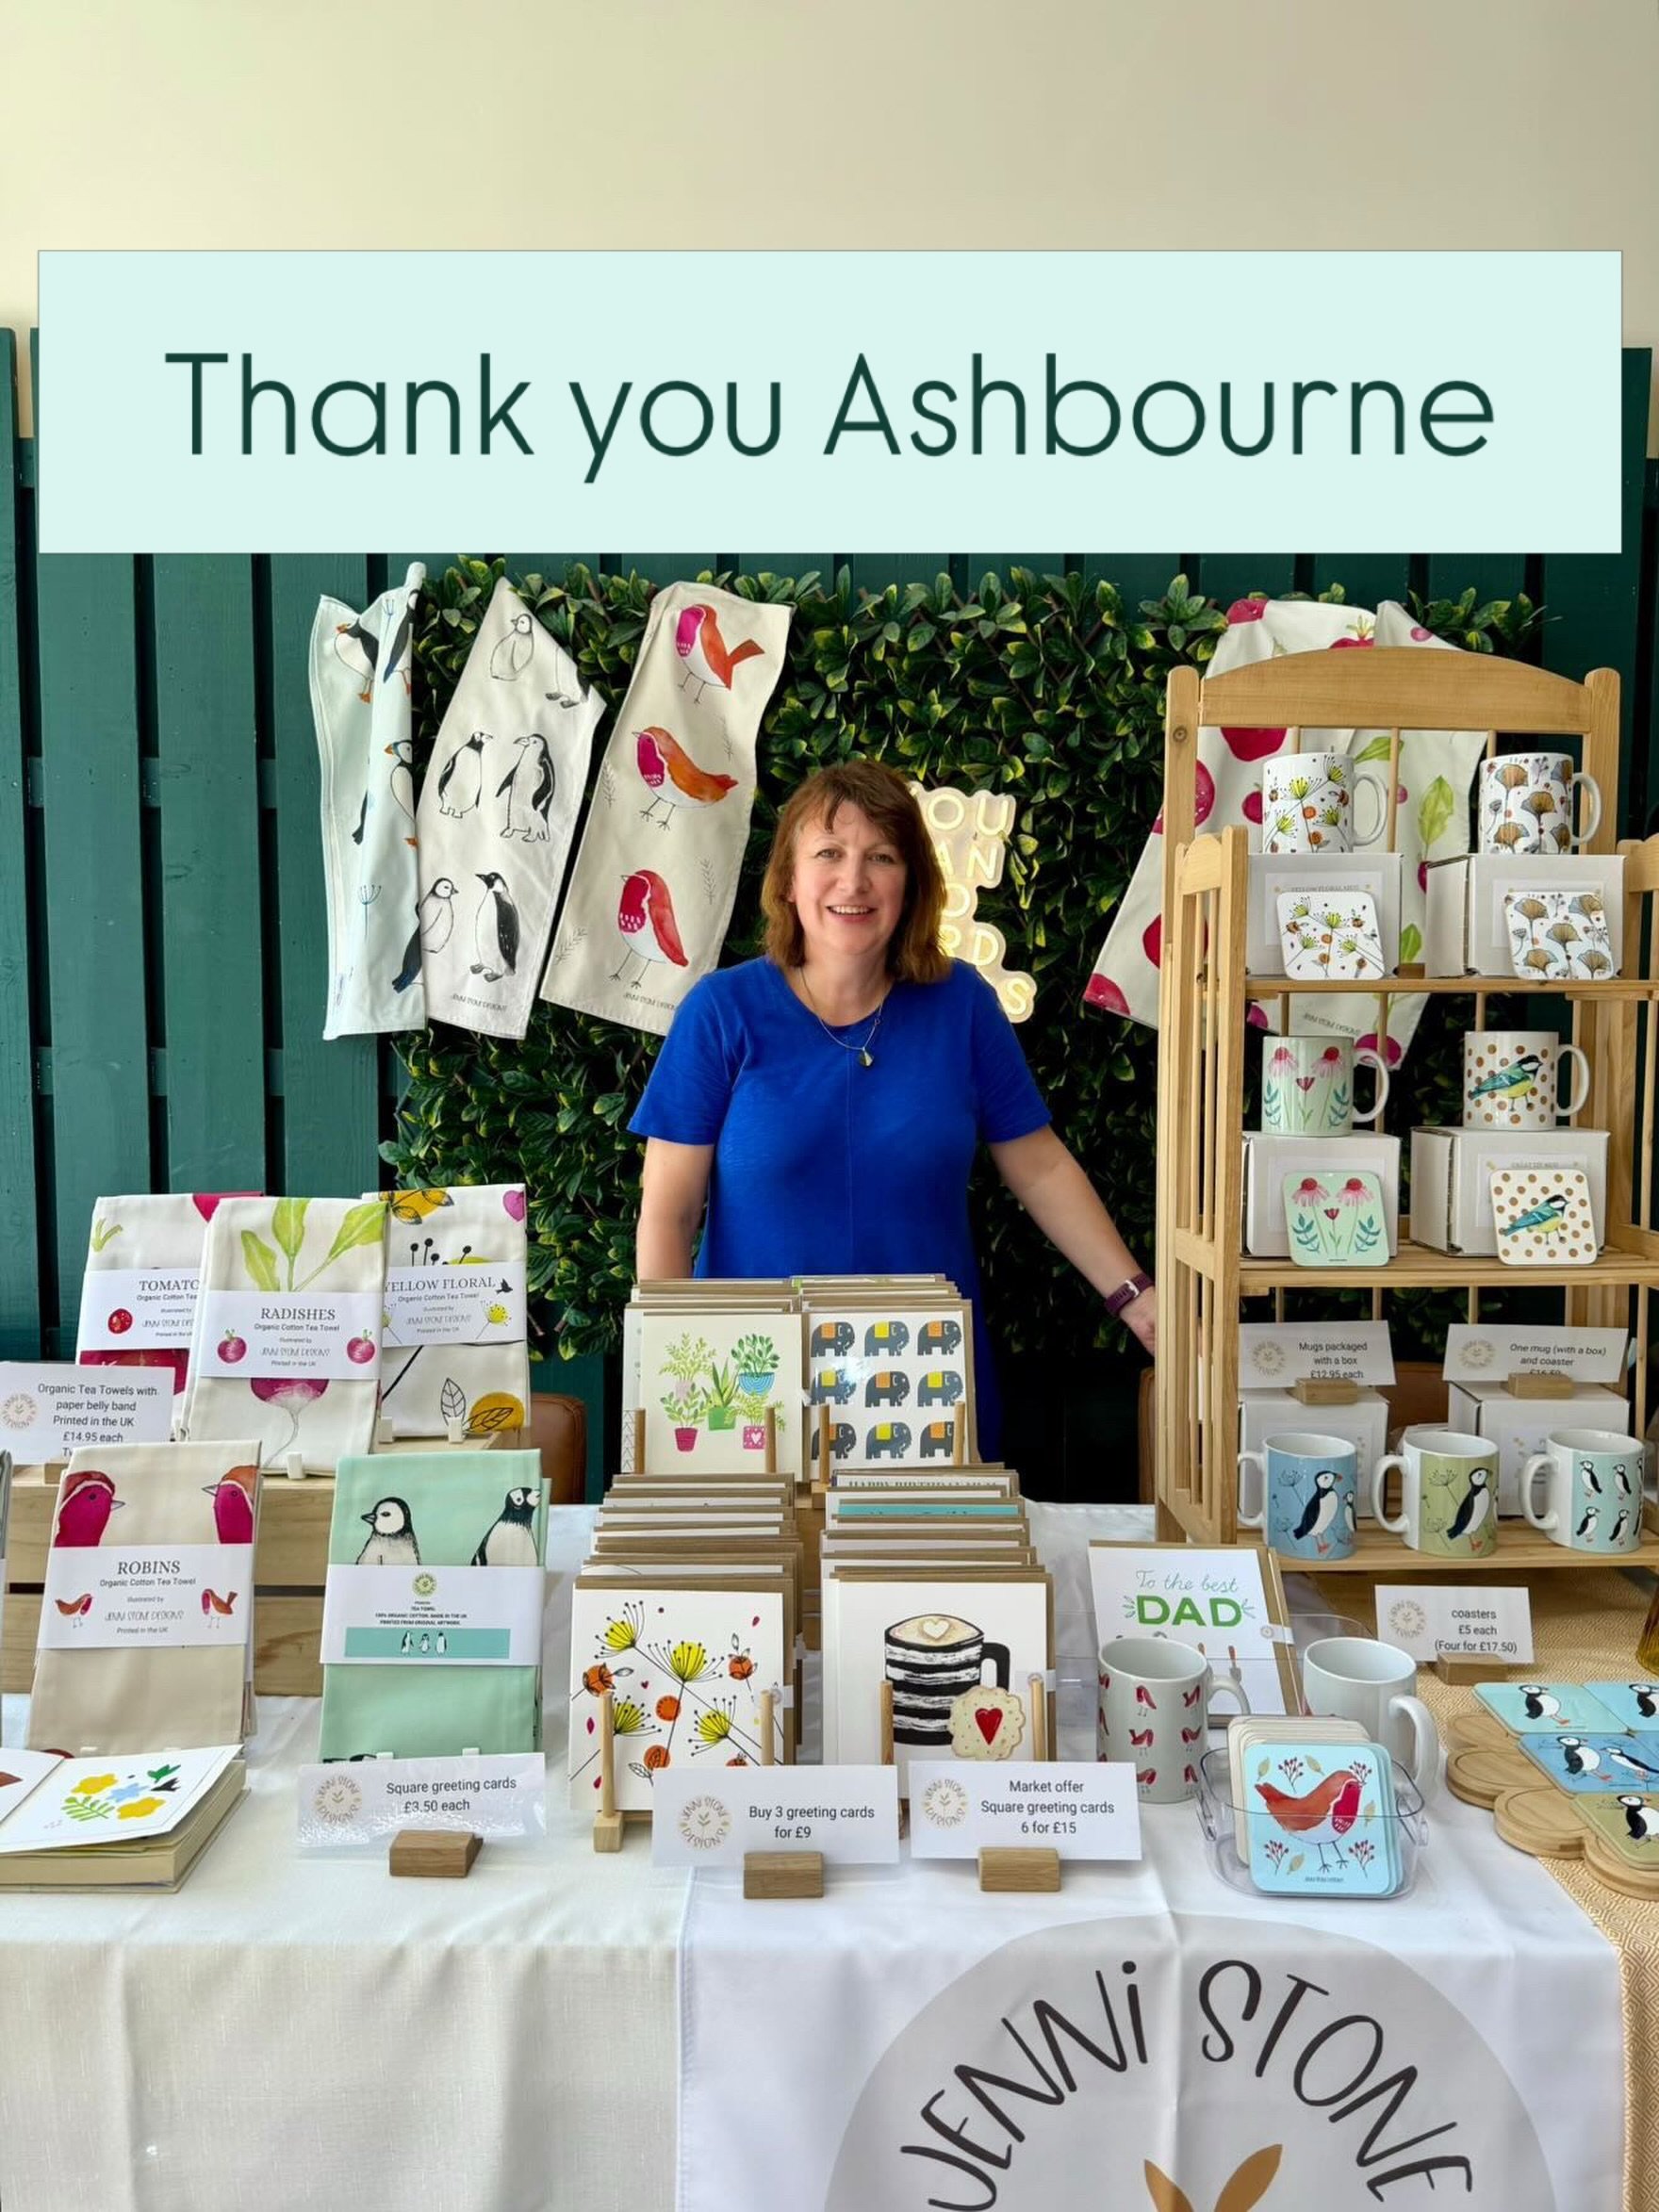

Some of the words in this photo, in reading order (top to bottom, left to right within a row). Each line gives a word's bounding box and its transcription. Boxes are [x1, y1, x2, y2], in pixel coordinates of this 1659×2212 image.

[442, 1276, 496, 1290] FLORAL
[260, 1307, 336, 1320] RADISHES
[254, 1323, 280, 1332] Organic
[1298, 1342, 1324, 1352] Mugs
[1325, 1341, 1368, 1352] packaged
[1510, 1343, 1529, 1352] One
[1530, 1345, 1551, 1354] mug
[1552, 1345, 1576, 1354] (with
[1585, 1346, 1607, 1357] box)
[1313, 1355, 1332, 1365] with
[1341, 1355, 1357, 1365] box
[1519, 1356, 1537, 1365] and
[1539, 1357, 1575, 1366] coaster
[1342, 1369, 1364, 1379] each
[38, 1383, 76, 1395] Organic
[78, 1385, 97, 1395] Tea
[100, 1385, 134, 1396] Towels
[136, 1385, 157, 1396] with
[56, 1402, 84, 1412] paper
[87, 1401, 109, 1412] belly
[111, 1401, 137, 1412] band
[53, 1415, 88, 1426] Printed
[90, 1416, 99, 1426] in
[102, 1416, 118, 1426] the
[120, 1417, 134, 1427] UK
[63, 1432, 97, 1442] £14.95
[99, 1432, 123, 1443] each
[117, 1560, 181, 1575] ROBINS
[100, 1579, 128, 1587] Organic
[129, 1578, 156, 1586] Cotton
[173, 1577, 196, 1585] Towel
[1135, 1569, 1156, 1589] To
[1164, 1572, 1193, 1591] the
[1201, 1574, 1239, 1593] best
[1136, 1595, 1242, 1628] DAD
[1451, 1609, 1497, 1620] coasters
[1458, 1625, 1471, 1635] £5
[1473, 1626, 1497, 1635] each
[1435, 1639, 1461, 1651] (Four
[1463, 1641, 1477, 1651] for
[1479, 1642, 1518, 1655] £17.50)
[386, 1781, 428, 1796] Square
[432, 1778, 480, 1795] greeting
[483, 1777, 517, 1791] cards
[1009, 1780, 1052, 1793] Market
[1055, 1779, 1084, 1793] offer
[403, 1800, 438, 1813] £3.50
[441, 1798, 470, 1811] each
[980, 1800, 1024, 1815] Square
[1027, 1801, 1077, 1816] greeting
[1080, 1801, 1115, 1814] cards
[748, 1806, 773, 1820] Buy
[775, 1806, 783, 1818] 3
[786, 1805, 837, 1821] greeting
[840, 1805, 875, 1819] cards
[774, 1826, 792, 1838] for
[795, 1826, 812, 1839] £9
[1021, 1822, 1029, 1834] 6
[1032, 1821, 1050, 1834] for
[1053, 1822, 1076, 1834] £15
[1197, 1958, 1473, 2204] STONE
